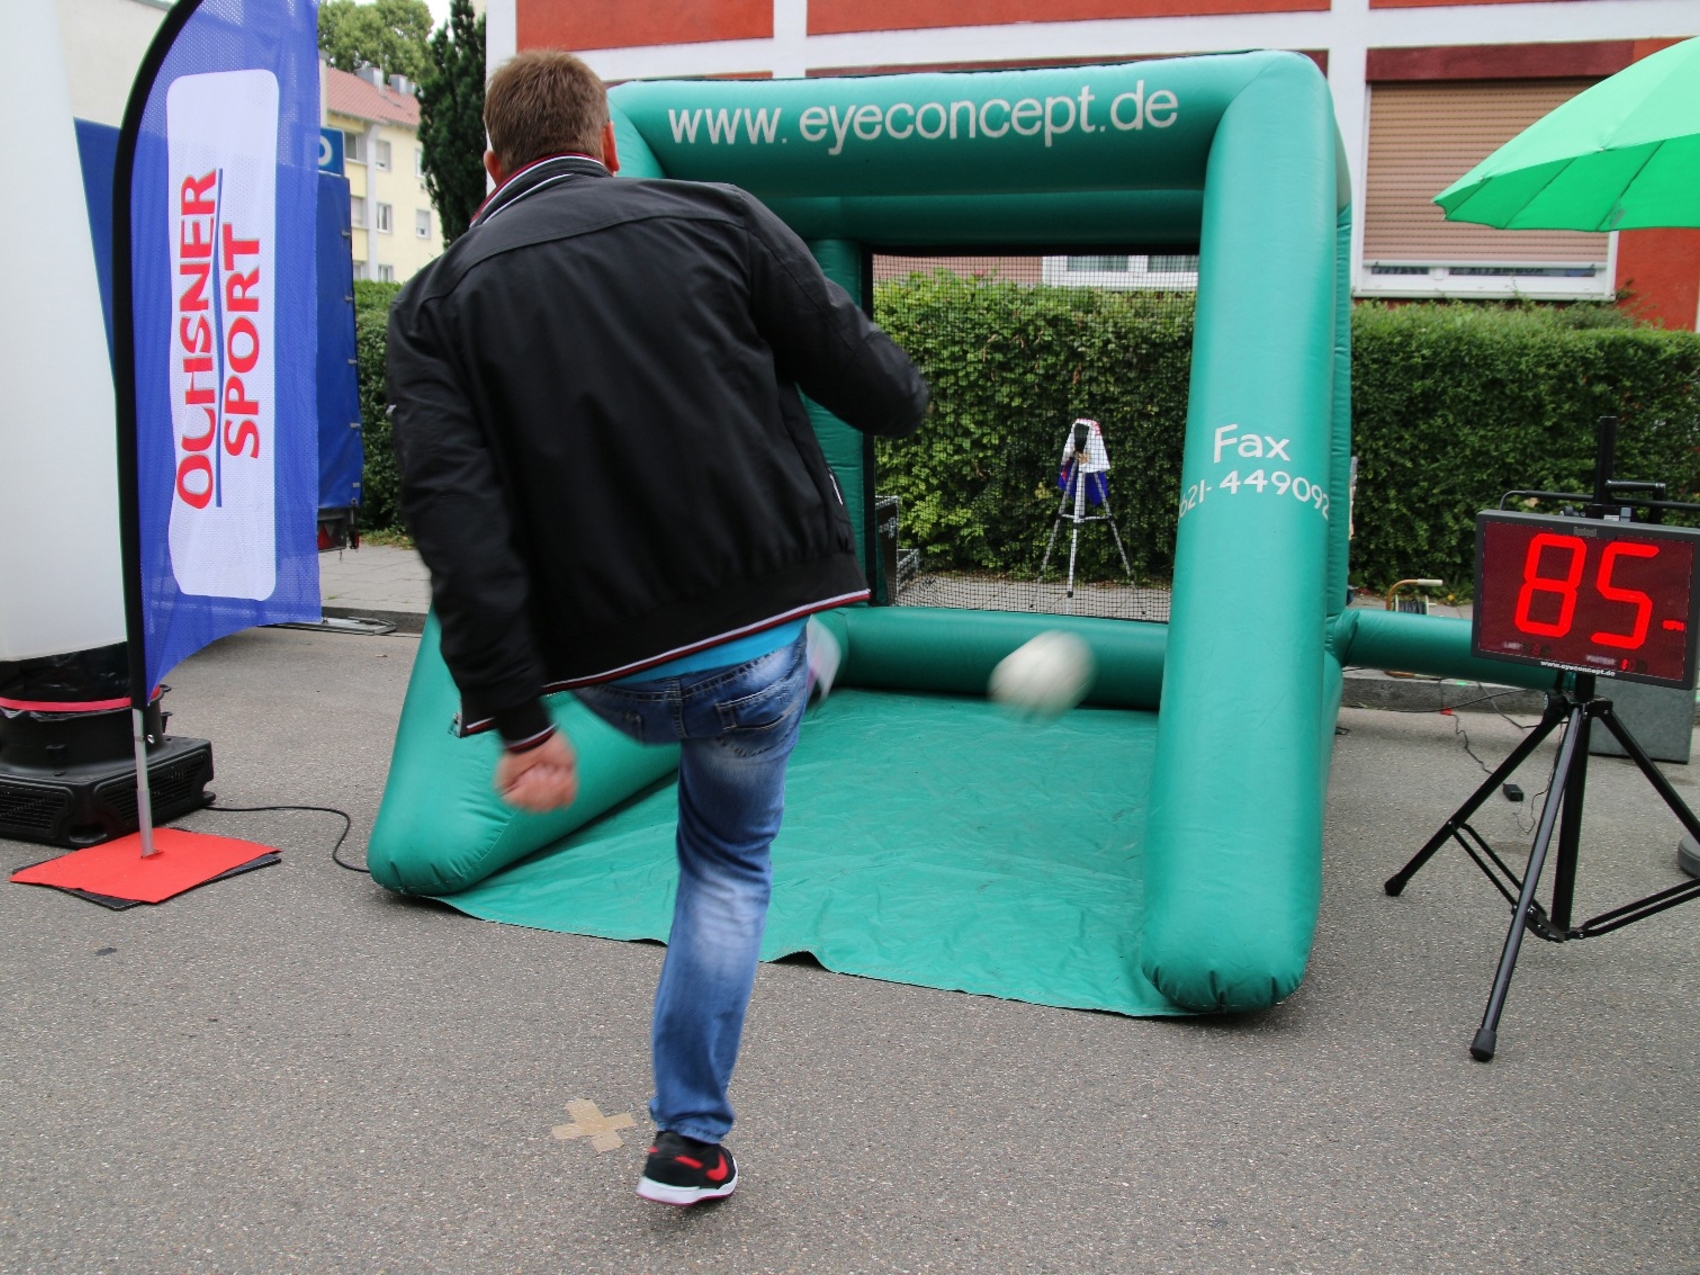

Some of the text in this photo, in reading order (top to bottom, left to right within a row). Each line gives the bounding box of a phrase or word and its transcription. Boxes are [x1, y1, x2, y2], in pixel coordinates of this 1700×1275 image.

[177, 169, 217, 509] OCHSNER
[223, 223, 260, 459] SPORT
[1213, 423, 1291, 464] Fax
[1514, 533, 1660, 650] 85
